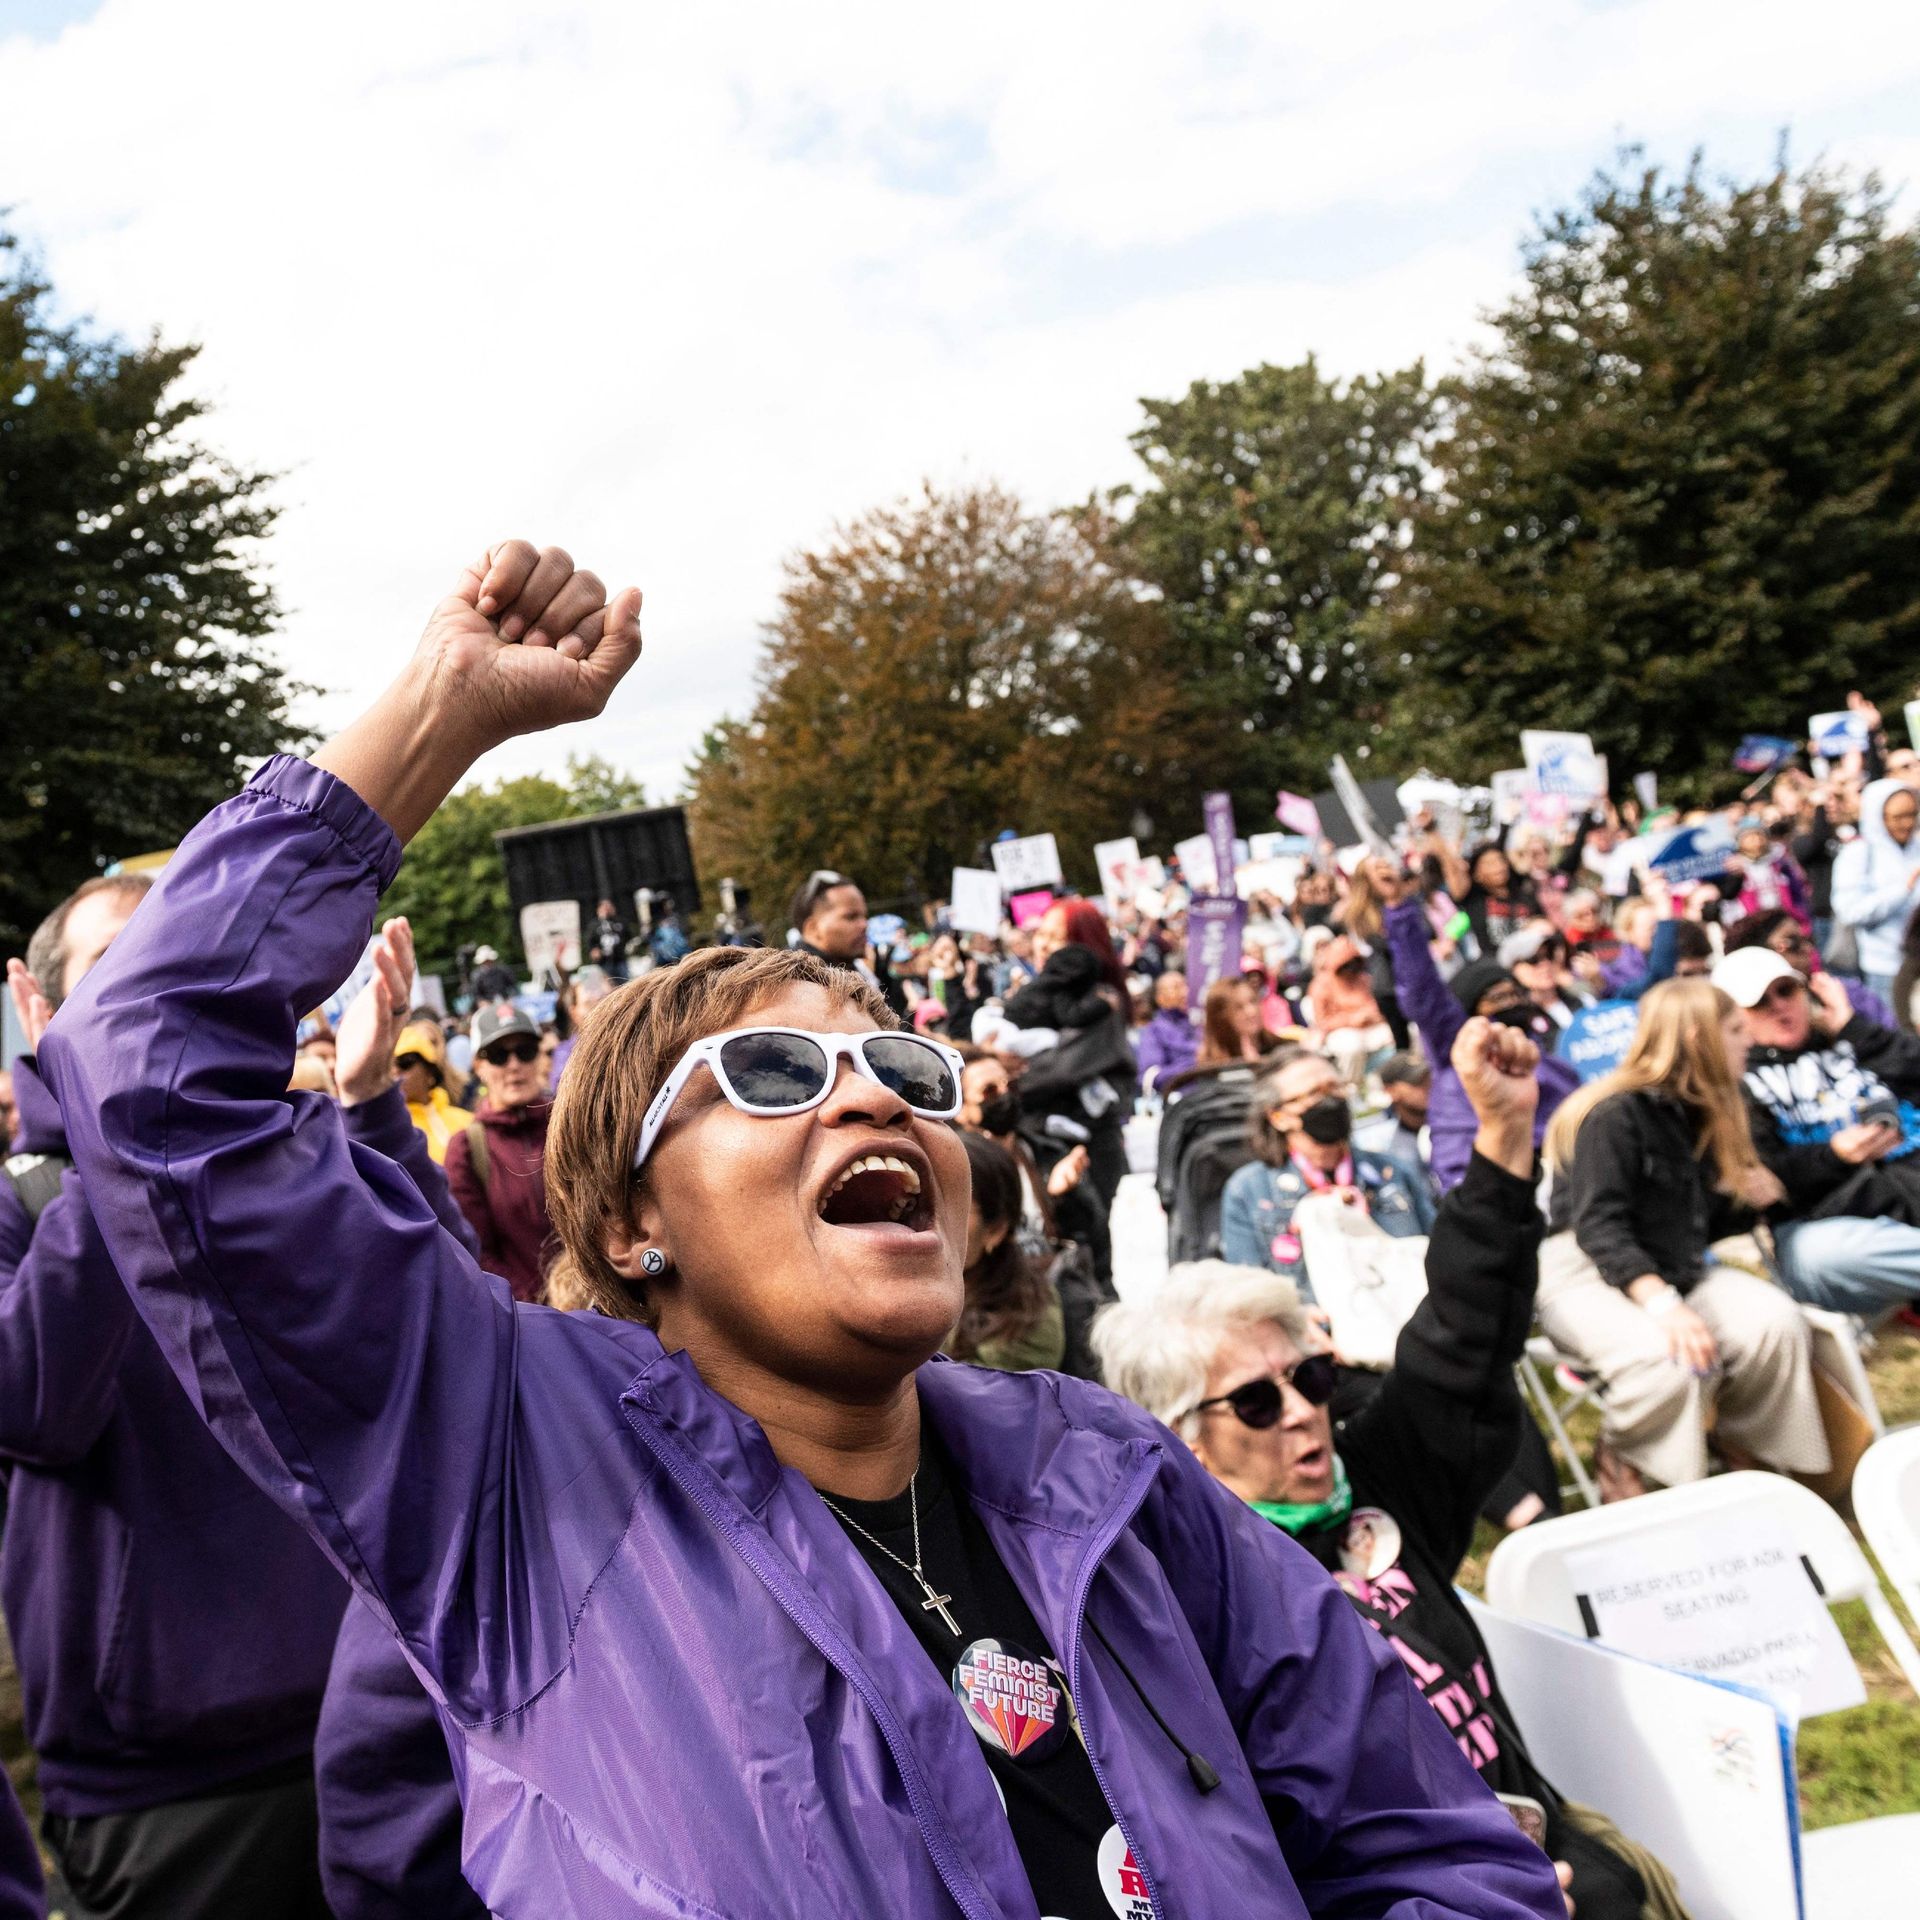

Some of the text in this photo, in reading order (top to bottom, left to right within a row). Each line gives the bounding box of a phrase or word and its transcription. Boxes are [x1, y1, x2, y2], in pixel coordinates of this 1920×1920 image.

[1596, 1568, 1705, 1605] RESERVED
[1709, 1557, 1750, 1579] FOR
[1662, 1585, 1751, 1621] SEATING
[959, 1663, 1061, 1707] FEMINIST
[972, 1648, 1048, 1684] FIERCE
[969, 1685, 1055, 1724] FUTURE
